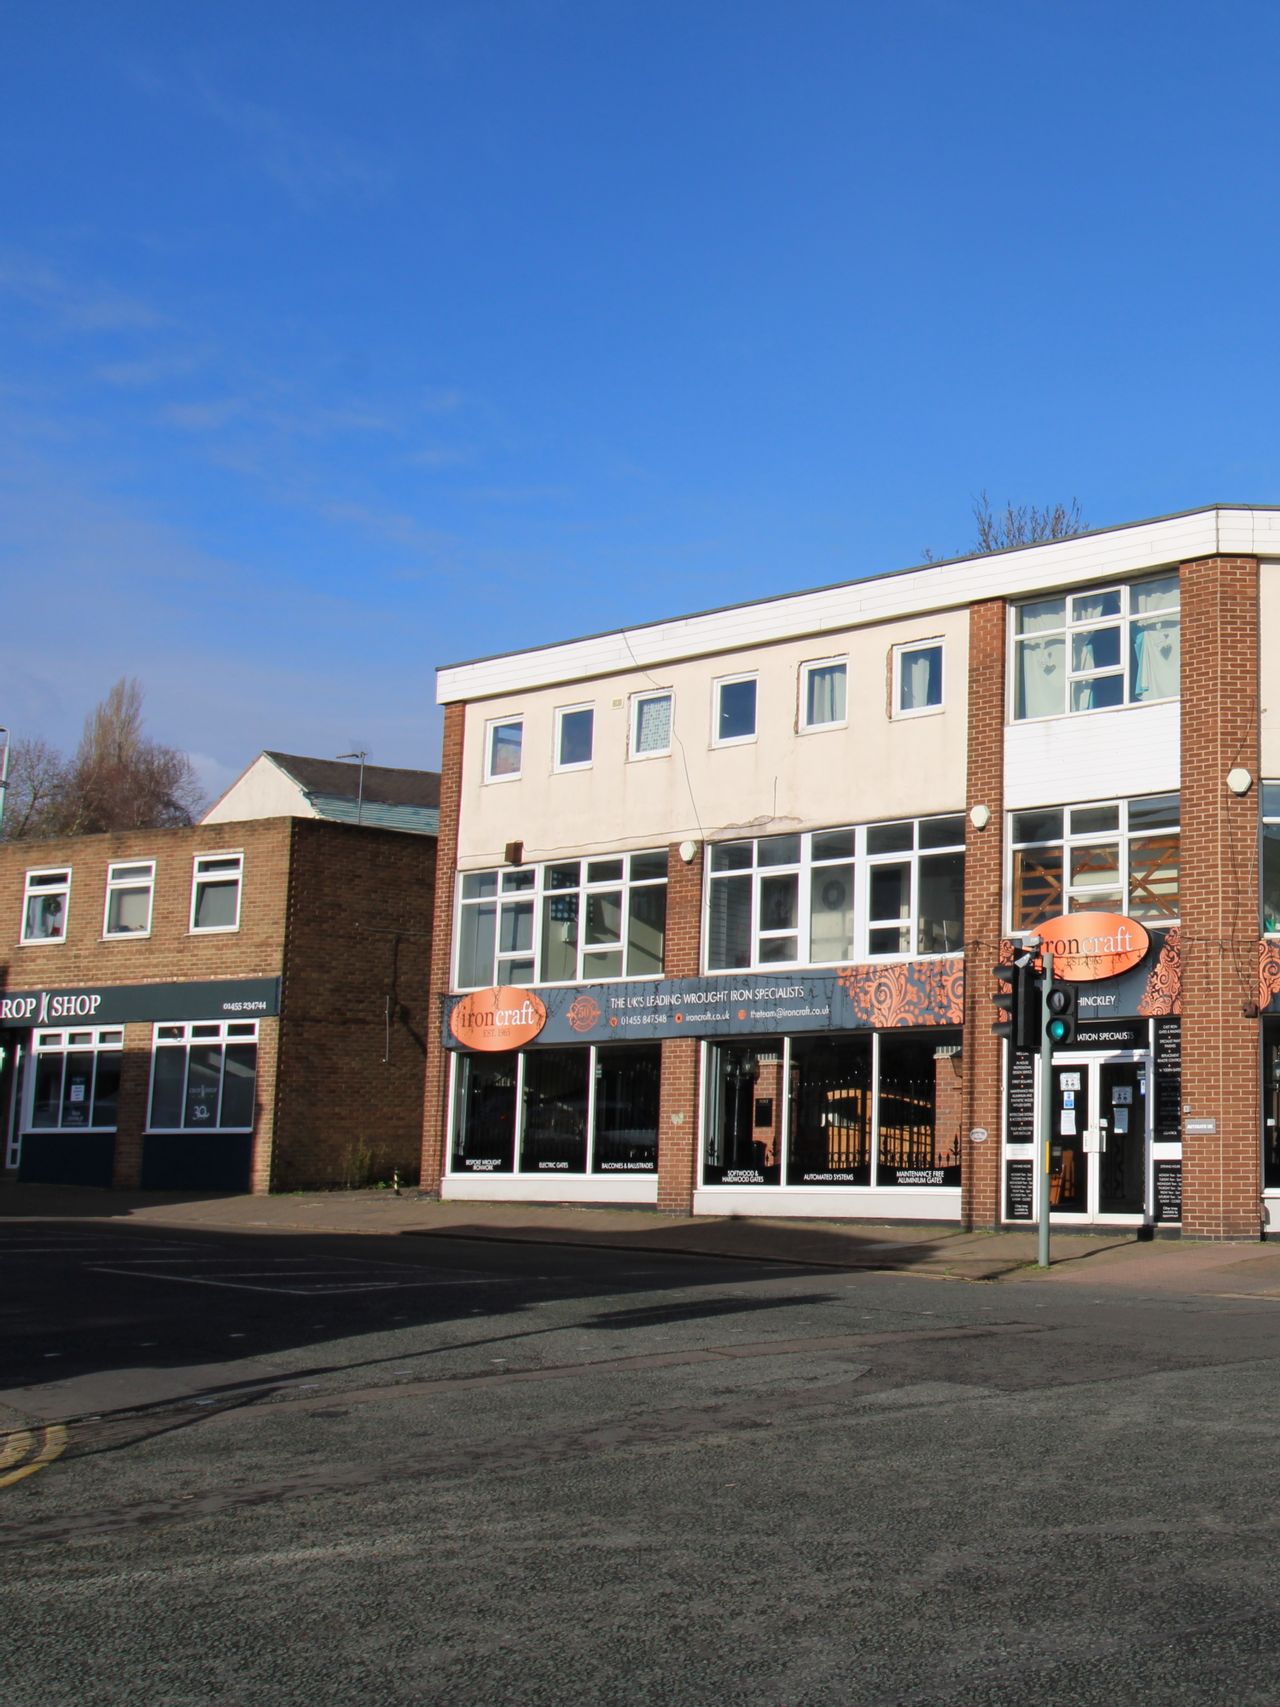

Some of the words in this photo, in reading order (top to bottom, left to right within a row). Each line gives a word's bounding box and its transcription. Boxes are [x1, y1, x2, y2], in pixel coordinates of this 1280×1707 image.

[1038, 926, 1132, 956] roncraft
[52, 994, 101, 1016] SHOP
[610, 998, 625, 1008] THE
[628, 996, 644, 1008] UK'S
[646, 994, 682, 1006] LEADING
[683, 991, 728, 1004] WROUGHT
[730, 990, 752, 1001] IRON
[754, 986, 804, 1000] SPECIALISTS
[461, 1000, 535, 1028] ironcraft
[620, 1016, 641, 1025] 01455
[643, 1014, 667, 1024] 847548
[1099, 1032, 1134, 1040] SPECIALISTS
